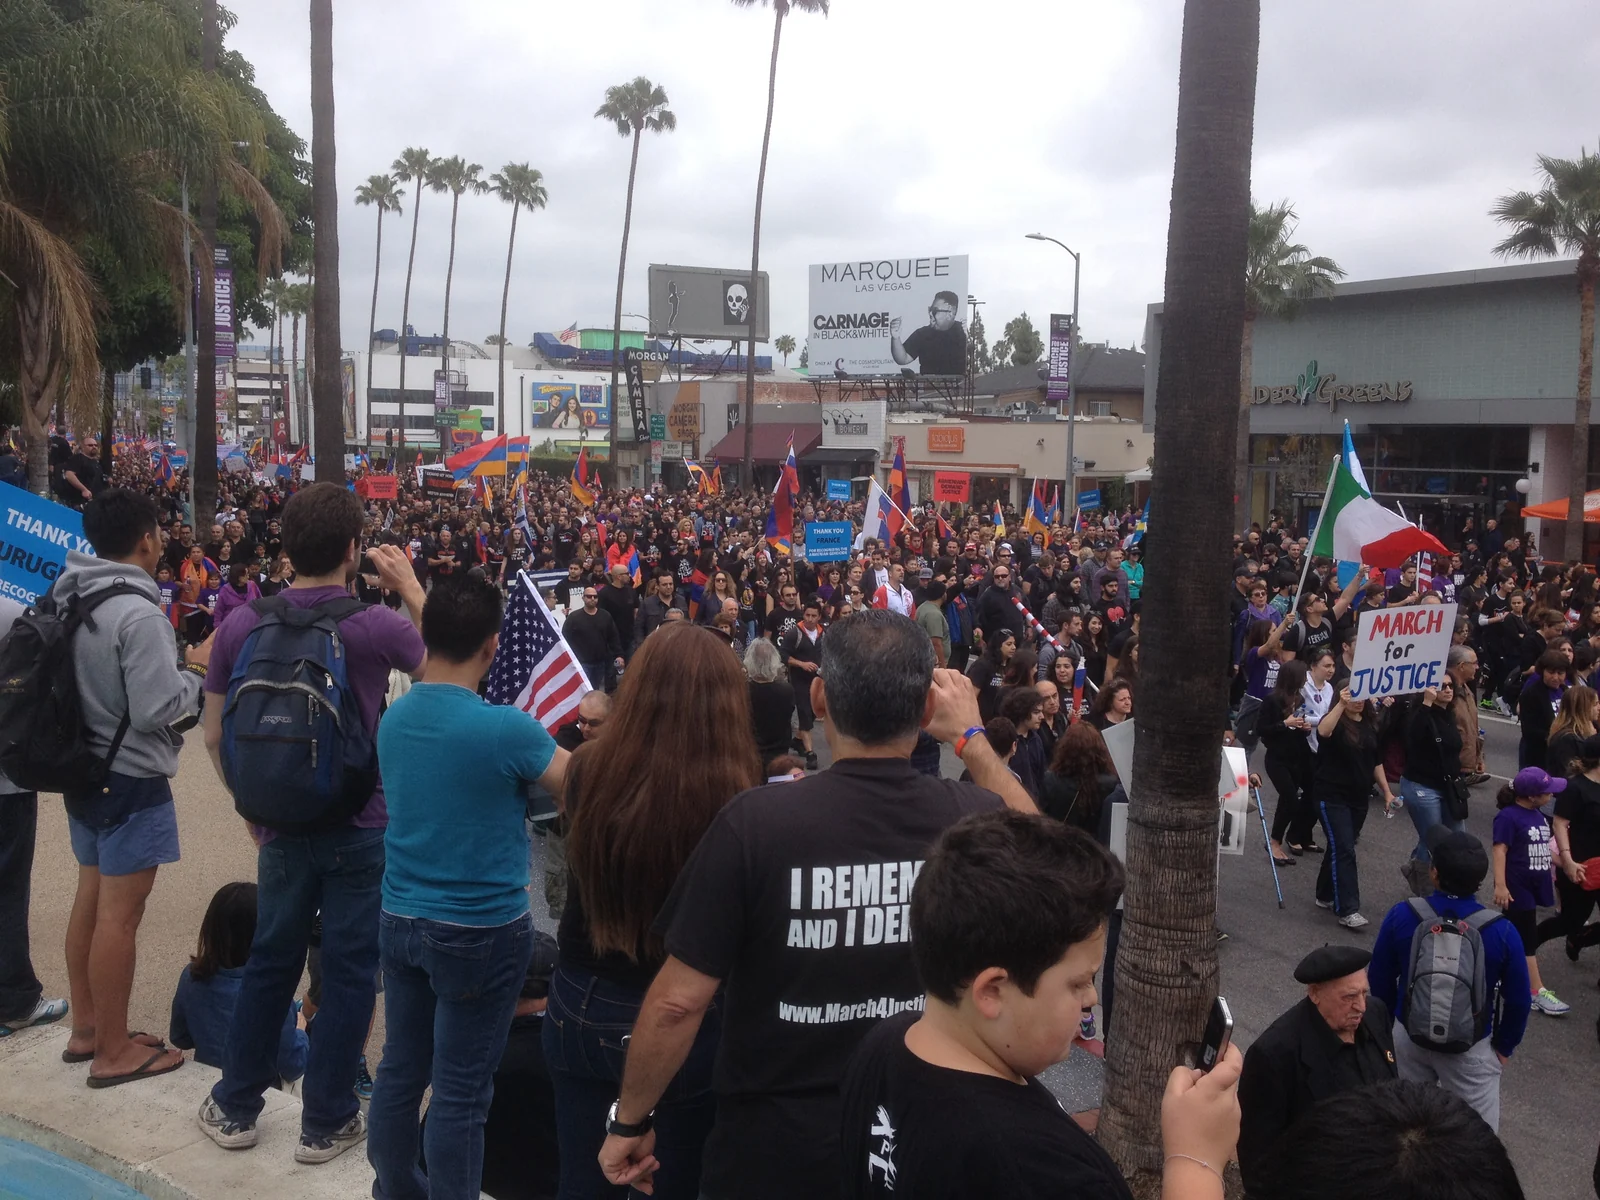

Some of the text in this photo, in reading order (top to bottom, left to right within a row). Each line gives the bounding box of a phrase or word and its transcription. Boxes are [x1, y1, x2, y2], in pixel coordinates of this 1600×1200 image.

[822, 257, 950, 282] MARQUEE
[856, 282, 912, 292] LAS VEGAS
[214, 278, 232, 327] JUSTICE
[814, 312, 890, 330] CARNAGE
[822, 329, 888, 340] BLACK&WHITE
[628, 351, 669, 361] MORGAN
[1050, 347, 1059, 378] MARCH
[1058, 341, 1069, 378] JUSTICE
[630, 366, 646, 430] CAMERA
[674, 404, 698, 413] MORGAN
[669, 415, 698, 427] CAMERA
[938, 478, 967, 486] ARMENIANS
[6, 508, 72, 548] THANK
[0, 541, 66, 581] URUG
[1369, 610, 1444, 641] MARCH
[1384, 640, 1414, 662] for
[1350, 660, 1442, 698] JUSTICE
[790, 868, 802, 910] I
[787, 919, 838, 950] AND
[844, 910, 856, 947] I
[779, 994, 926, 1024] www.March4Justi
